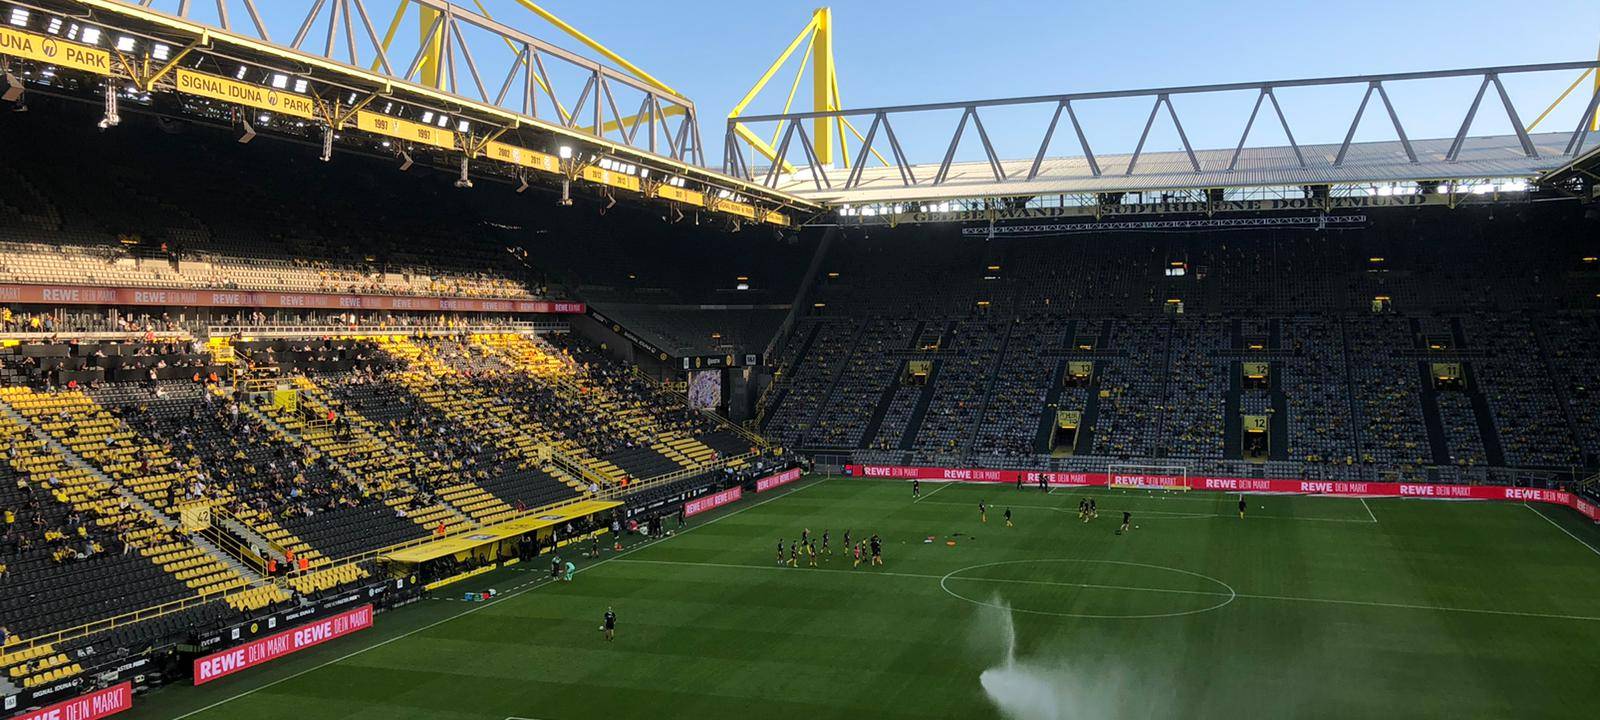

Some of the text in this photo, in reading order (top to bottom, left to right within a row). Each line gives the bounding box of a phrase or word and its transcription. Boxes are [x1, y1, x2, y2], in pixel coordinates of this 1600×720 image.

[66, 48, 106, 69] PARK
[182, 75, 311, 114] SIGNAL IDUNA PARK
[1272, 195, 1426, 209] DORTMUND
[999, 206, 1065, 218] WAND
[43, 288, 79, 301] REWE
[135, 291, 166, 303] REWE
[213, 293, 239, 304] REWE
[281, 295, 304, 306] REWE
[340, 297, 361, 308] REWE
[393, 299, 411, 309] REWE
[921, 363, 929, 371] 14
[1081, 364, 1090, 372] 13
[1256, 365, 1266, 374] 12
[1448, 366, 1456, 375] 11
[1254, 419, 1265, 427] 12
[865, 467, 891, 476] REWE
[944, 469, 1001, 480] REWE DEIN MARKT
[1028, 473, 1086, 484] REE DEIN MARKT
[1115, 476, 1144, 485] REWE
[1159, 477, 1176, 487] MARKT
[1206, 479, 1270, 489] REWE DEIN MARKT
[1301, 482, 1367, 493] REWE DEIN MARKT
[1400, 485, 1471, 496] REWE DEIN MARKT
[1505, 488, 1541, 499] REWE
[197, 511, 209, 522] 42
[294, 621, 332, 648] REWE
[334, 618, 349, 634] DEIN
[349, 608, 369, 628] MARKT
[200, 635, 290, 680] REWE DEIN MARKT
[33, 681, 72, 699] SIGNAL IDUNA
[66, 697, 92, 720] DEIN
[93, 687, 125, 715] MARKT
